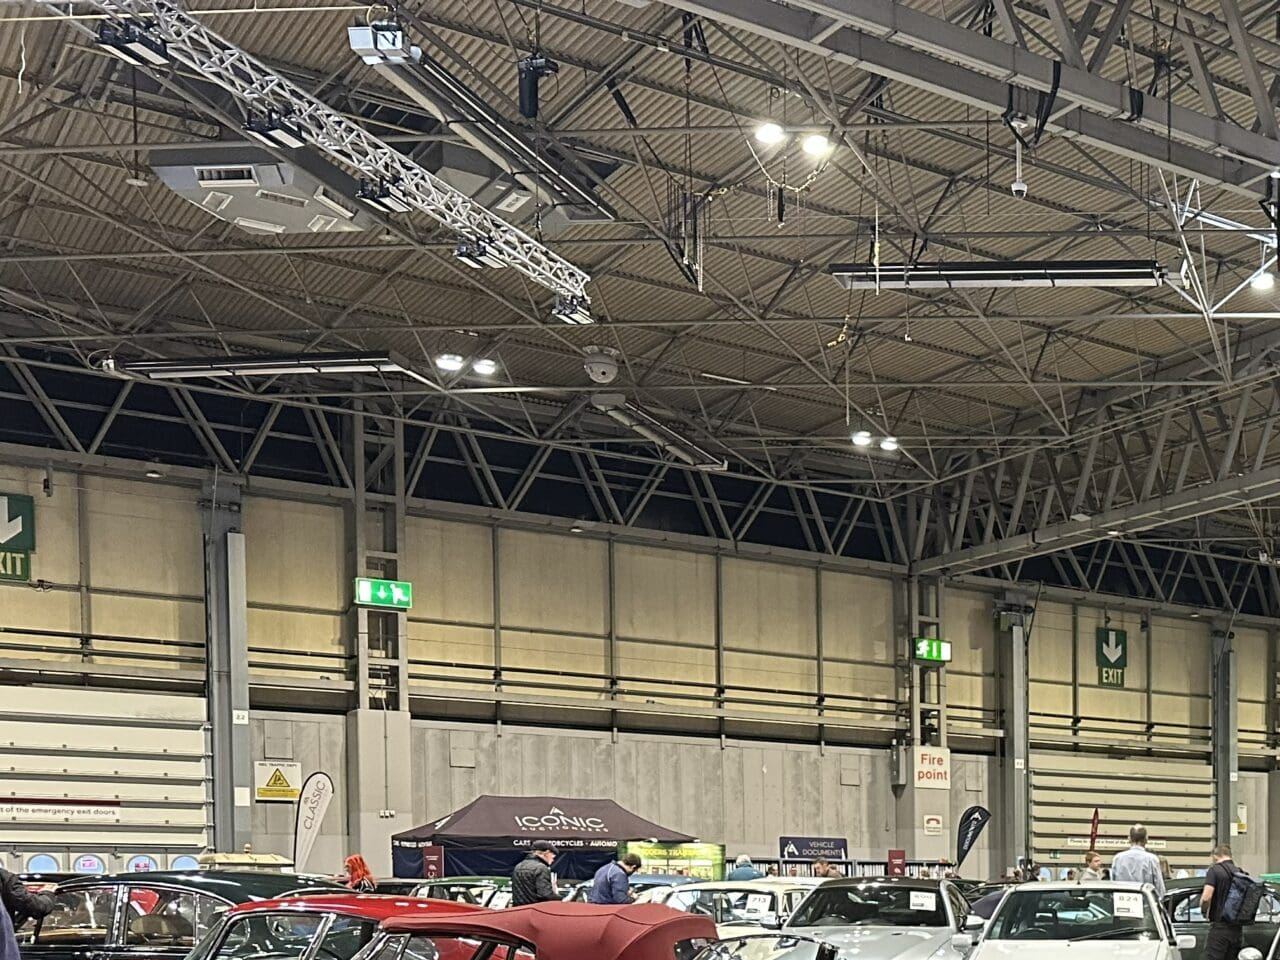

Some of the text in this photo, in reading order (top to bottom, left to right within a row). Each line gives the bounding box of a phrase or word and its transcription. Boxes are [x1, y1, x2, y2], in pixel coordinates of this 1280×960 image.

[0, 552, 25, 575] XIT
[1102, 667, 1123, 685] EXIT
[920, 753, 944, 766] Fire
[917, 769, 948, 780] point
[303, 780, 326, 830] CLASSIC
[31, 808, 75, 816] emergency
[514, 815, 605, 828] ICONIC
[809, 841, 835, 849] VEHICLE
